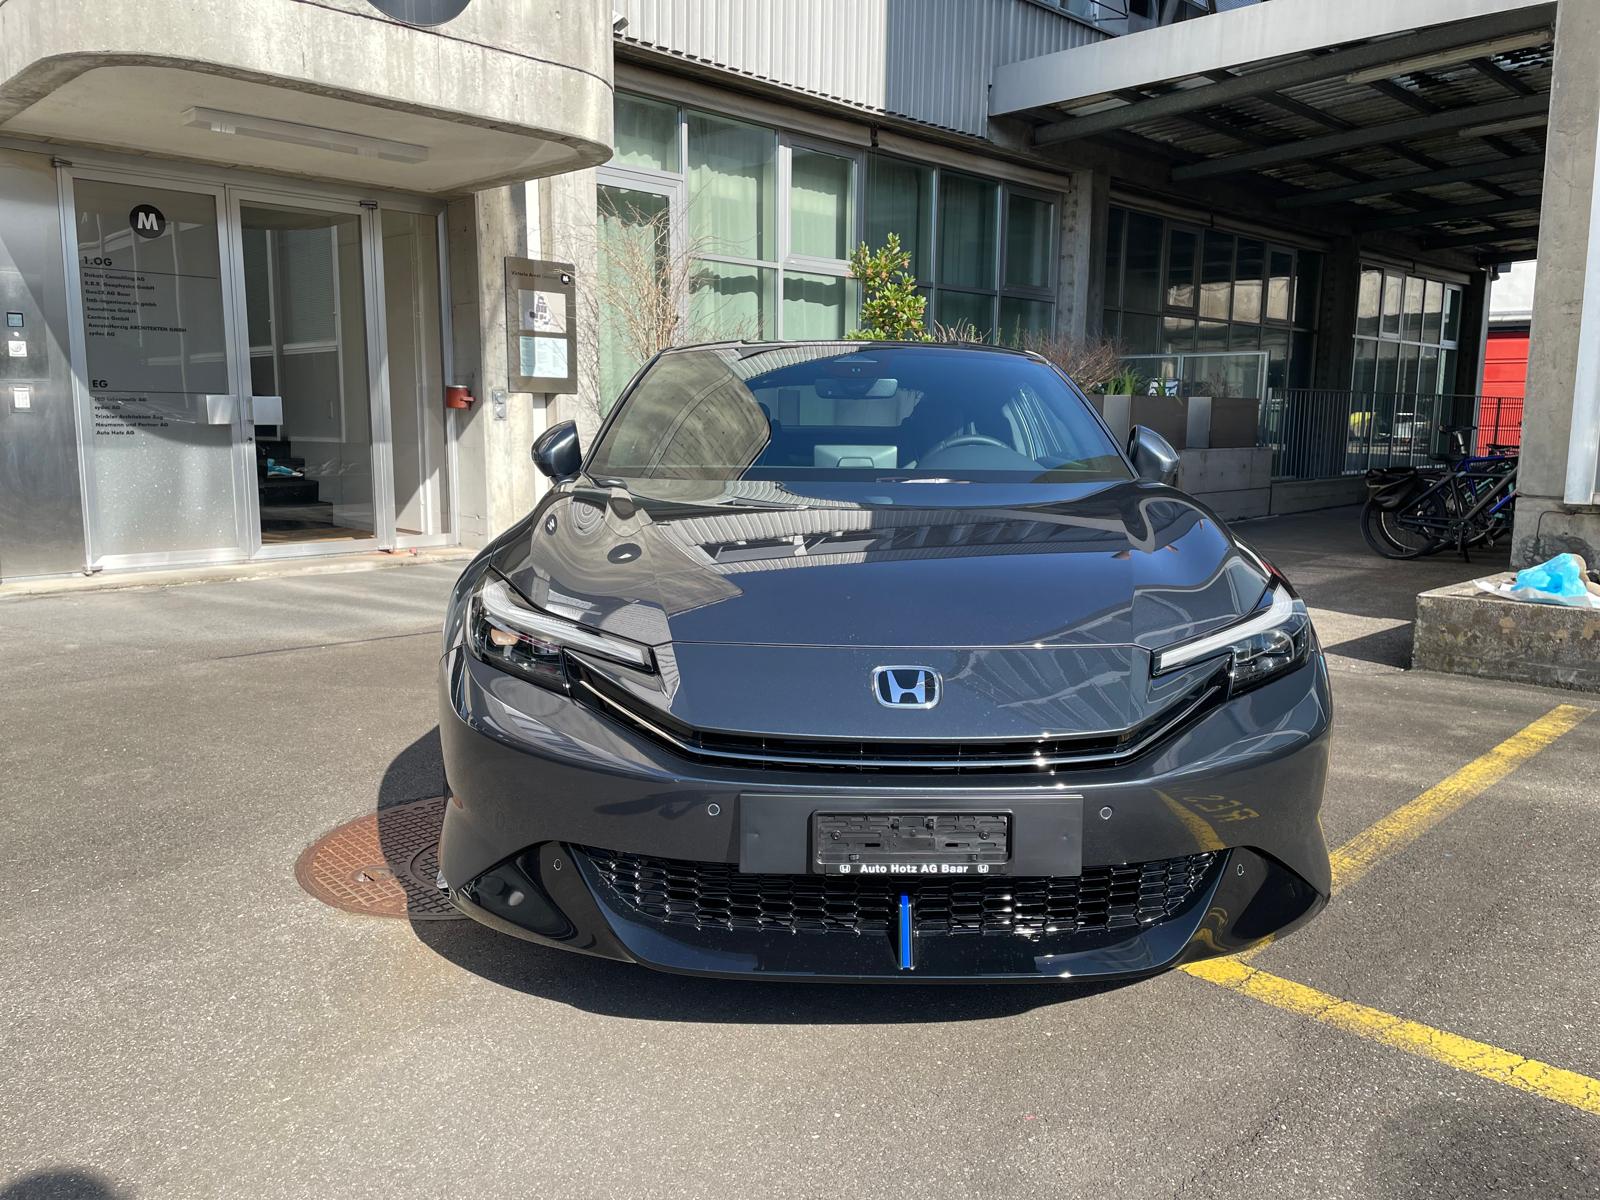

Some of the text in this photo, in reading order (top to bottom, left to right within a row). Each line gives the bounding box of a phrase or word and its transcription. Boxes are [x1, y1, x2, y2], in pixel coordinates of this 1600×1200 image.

[137, 211, 159, 231] M
[83, 256, 113, 266] 1.OG
[92, 379, 108, 388] EG
[859, 863, 888, 874] Auto
[890, 863, 918, 874] Hotz
[921, 863, 939, 874] AG
[941, 863, 969, 874] Baar
